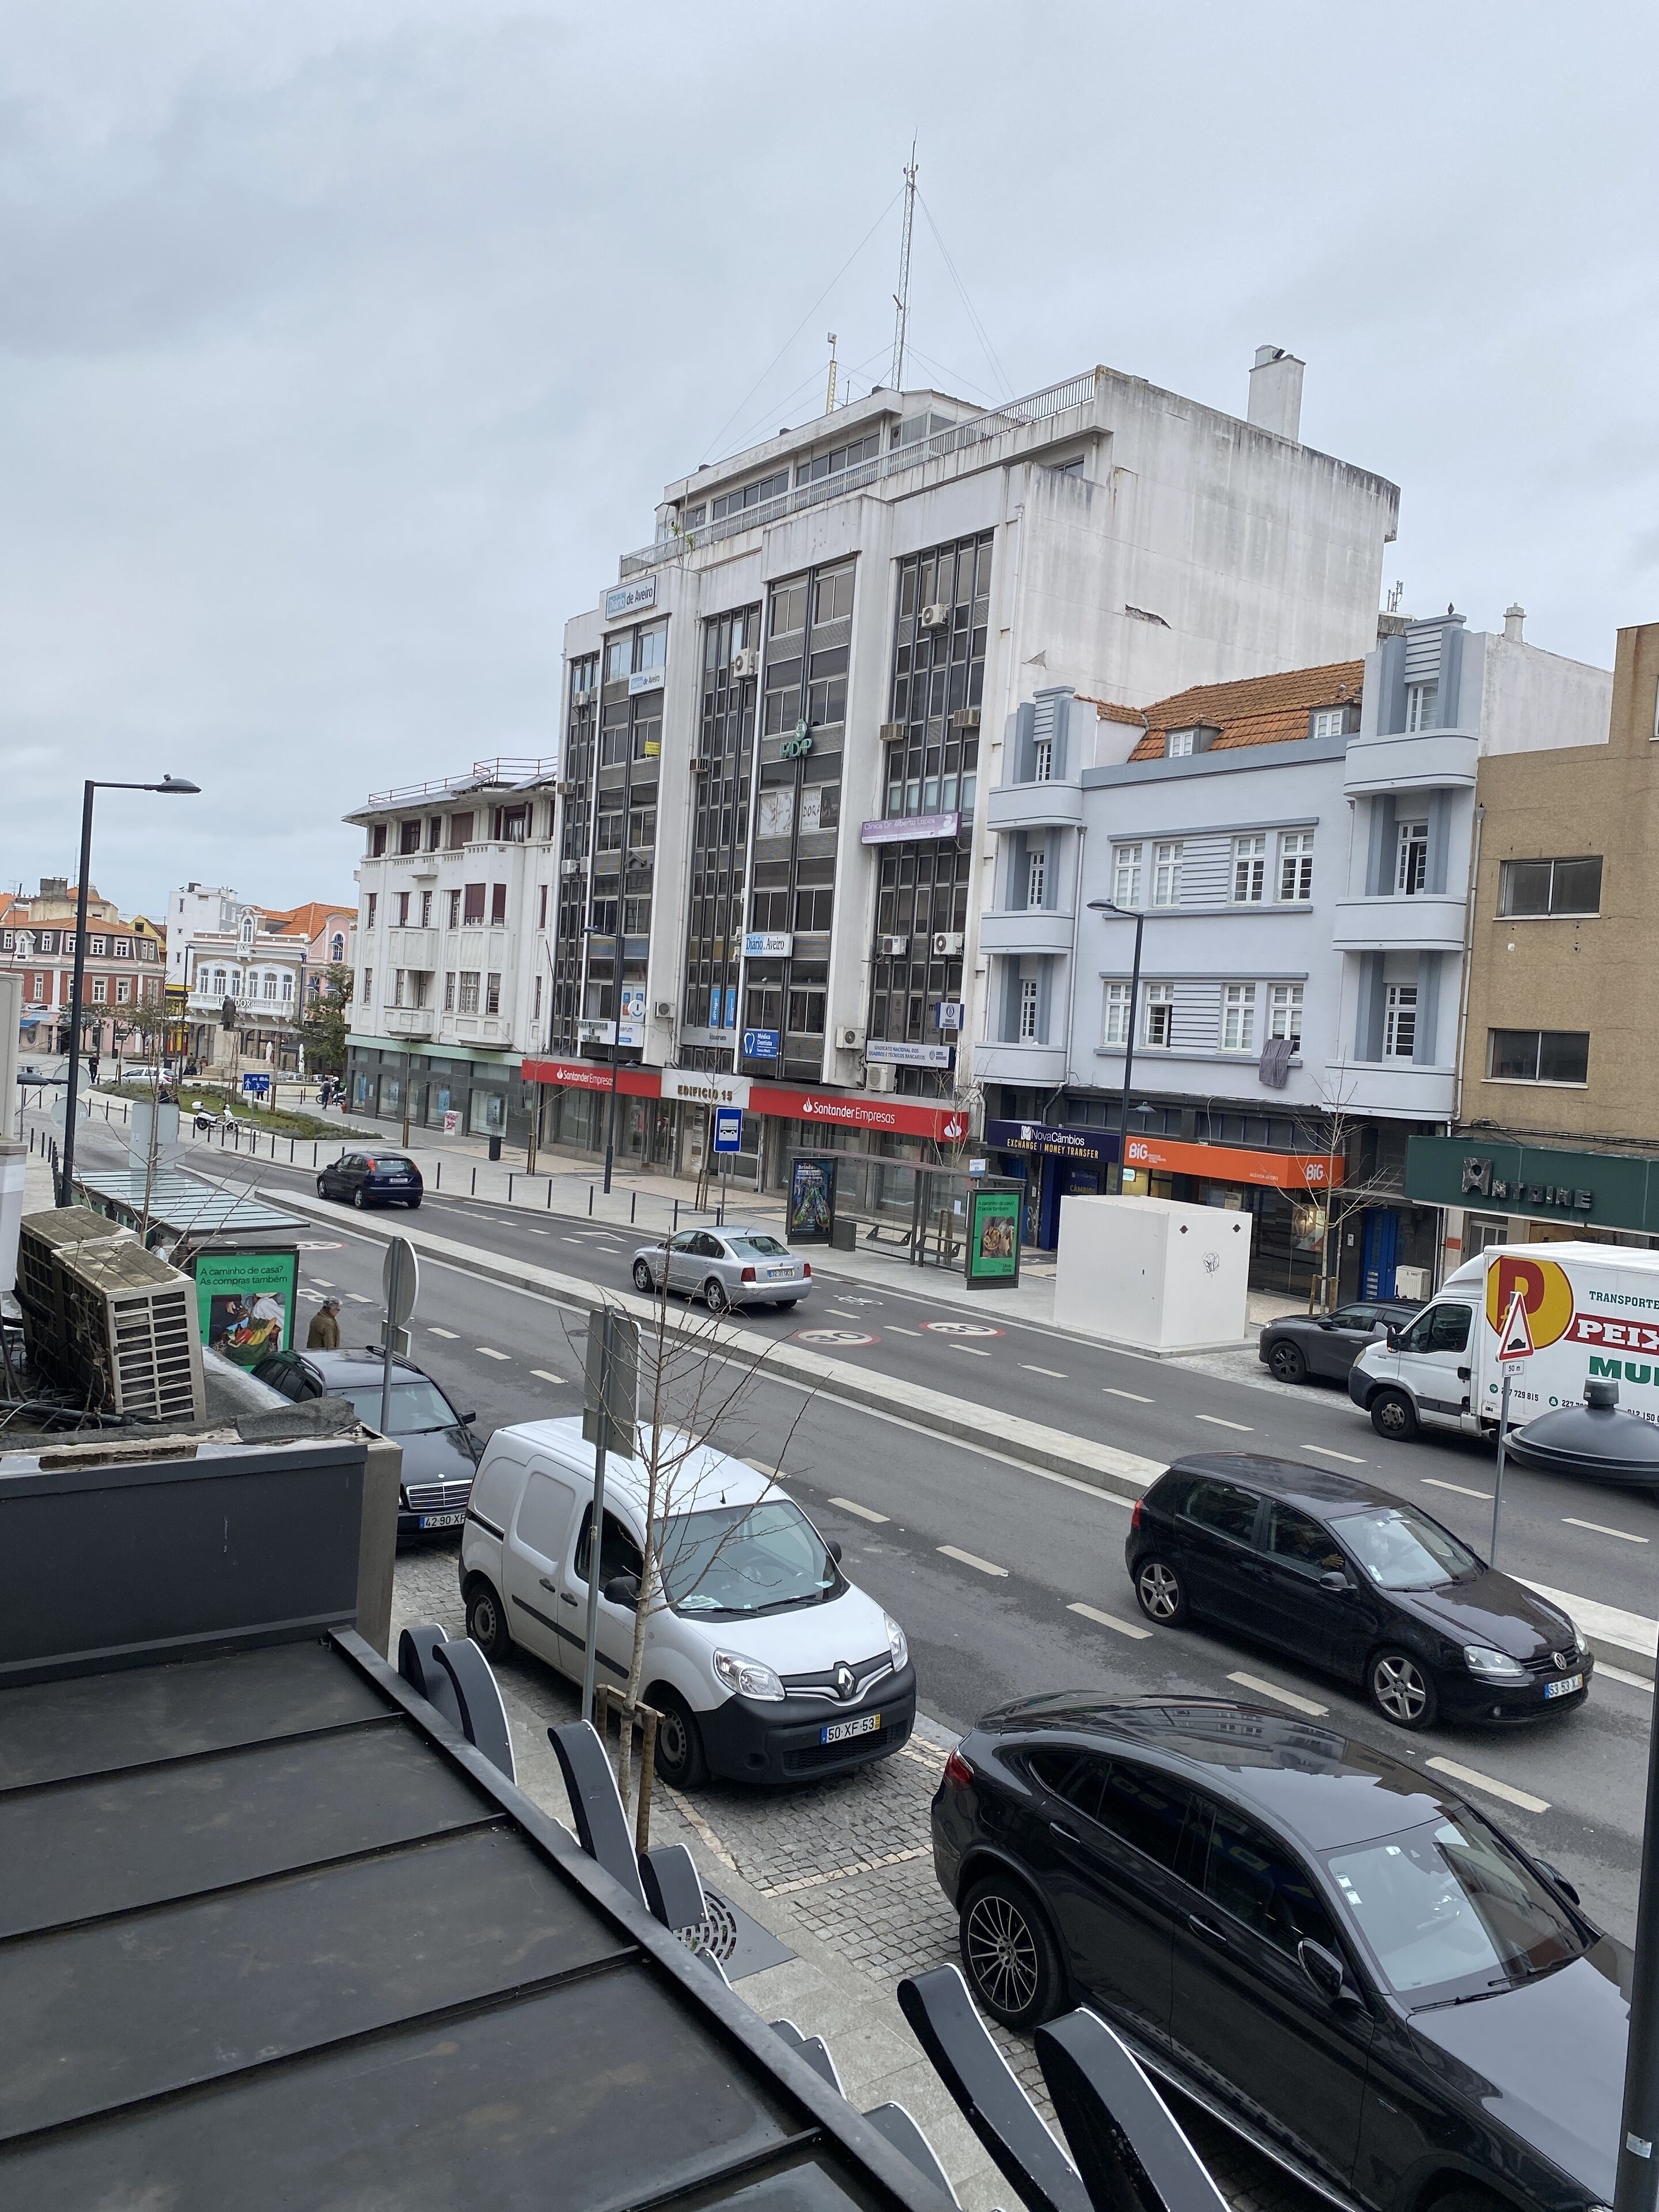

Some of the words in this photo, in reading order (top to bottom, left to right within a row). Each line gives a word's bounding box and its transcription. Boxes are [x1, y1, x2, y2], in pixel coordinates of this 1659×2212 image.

[627, 593, 633, 605] de
[635, 586, 653, 602] Aveiro
[894, 819, 915, 827] Alberto
[746, 937, 763, 949] Diário
[766, 937, 784, 949] Aveiro
[563, 1070, 589, 1082] Santander
[722, 1090, 732, 1101] 15
[814, 1101, 855, 1118] Santander
[855, 1107, 895, 1124] Empresas
[1031, 1129, 1085, 1146] NovaCâmbios
[1007, 1139, 1037, 1150] EXCHANGE
[1044, 1143, 1065, 1154] MONEY
[1067, 1147, 1099, 1159] TRANSFER
[213, 1278, 250, 1286] compras
[1501, 1387, 1513, 1396] 27
[1514, 1390, 1525, 1399] 729
[1527, 1393, 1539, 1402] 815
[1643, 1412, 1655, 1422] 150
